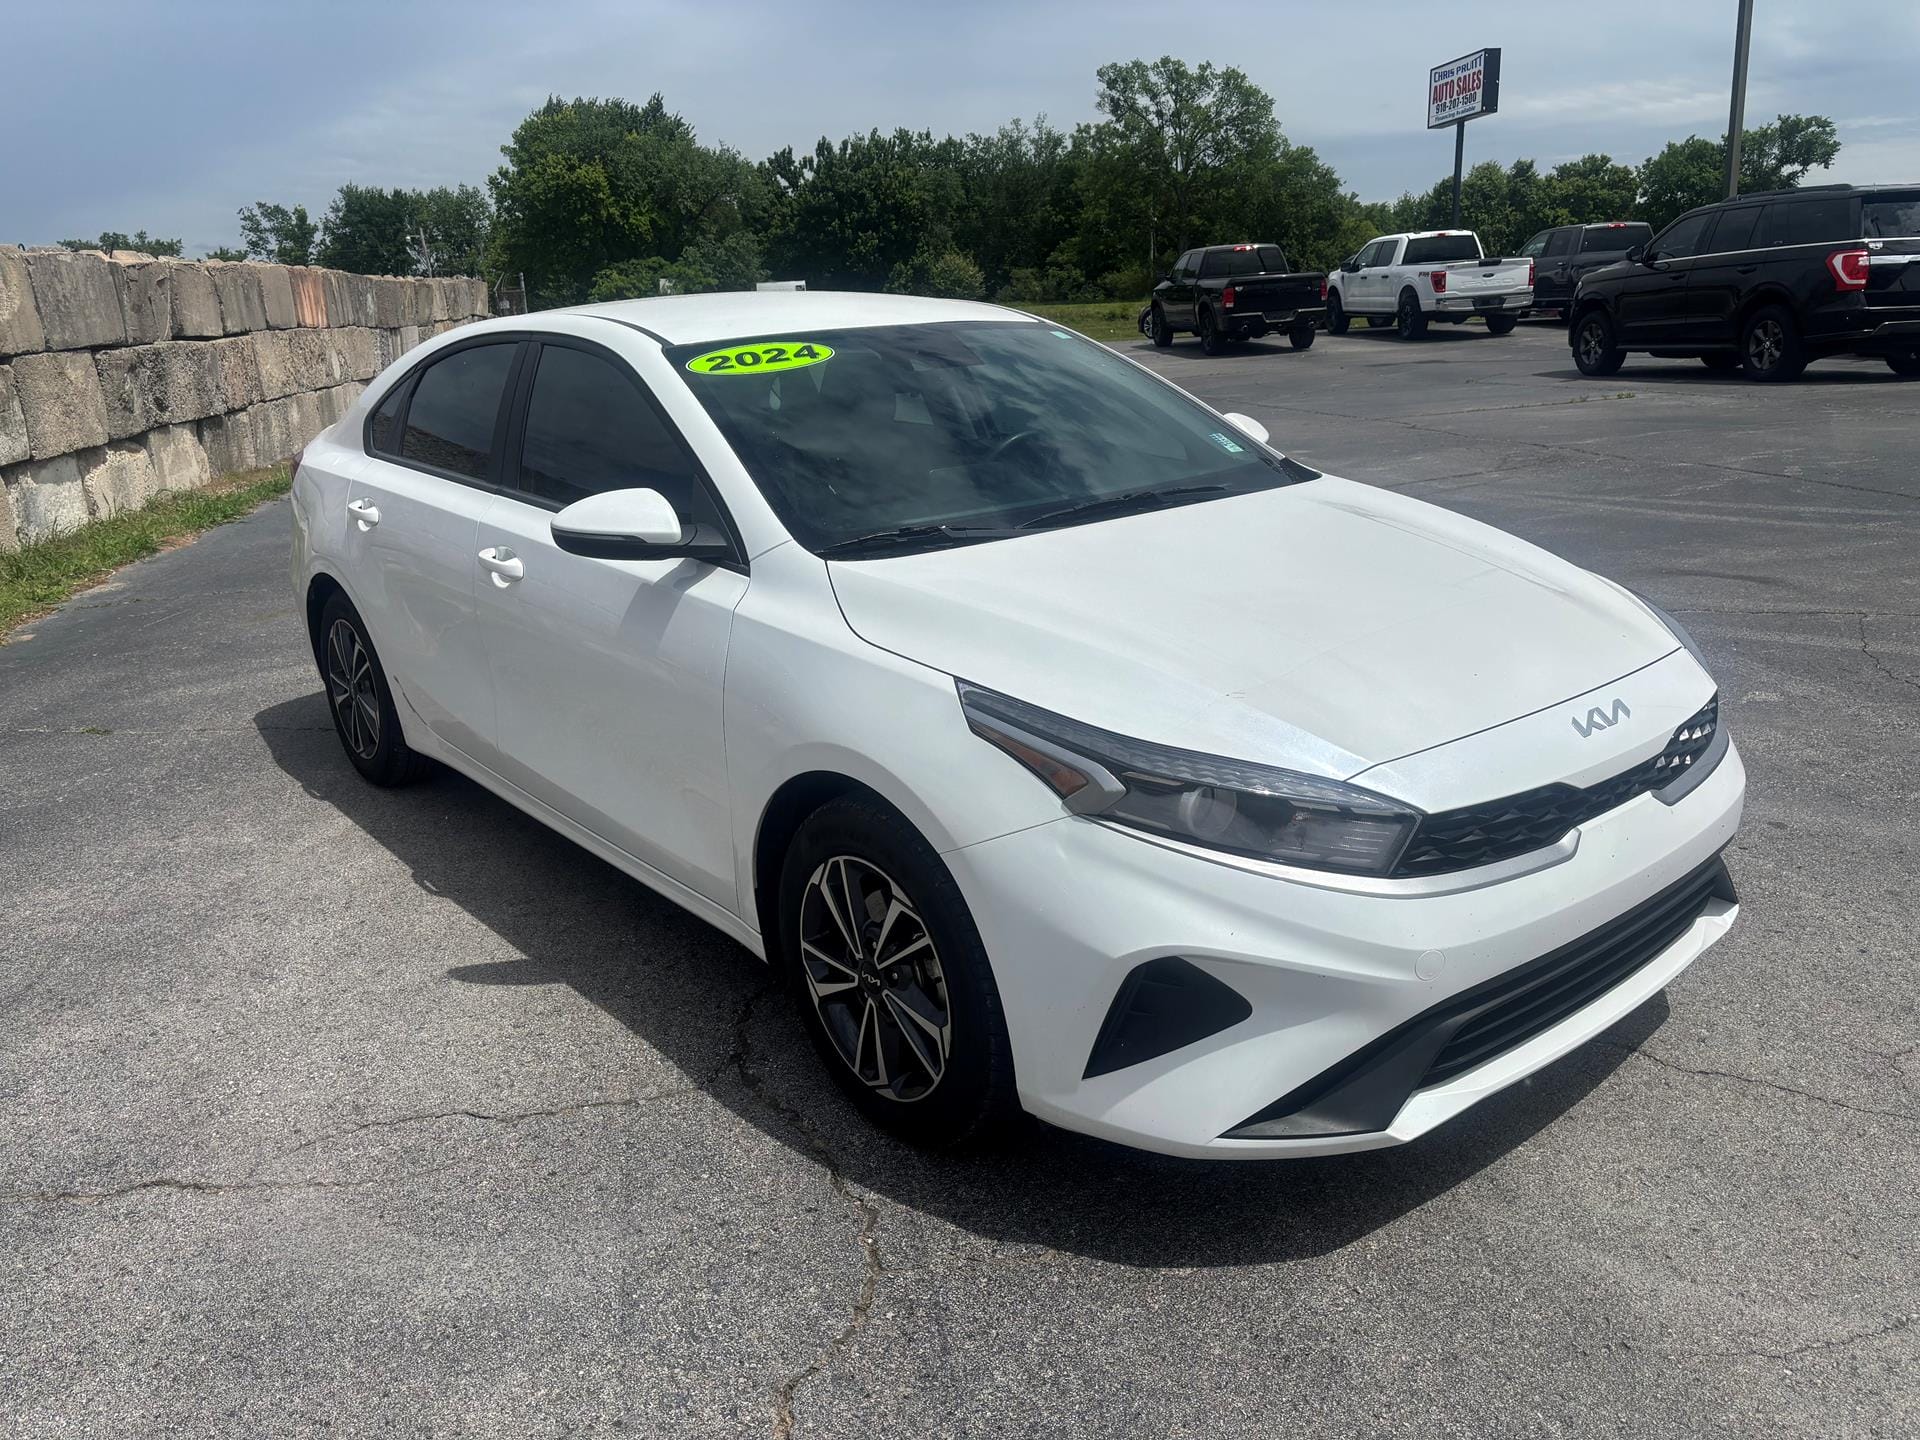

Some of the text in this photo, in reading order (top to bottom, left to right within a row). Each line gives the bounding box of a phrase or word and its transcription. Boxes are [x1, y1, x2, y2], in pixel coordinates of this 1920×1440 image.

[1434, 54, 1483, 82] CHRIS PRUITT
[1432, 69, 1482, 105] AUTO SALES
[706, 344, 820, 371] 2024
[1571, 698, 1631, 738] KIA
